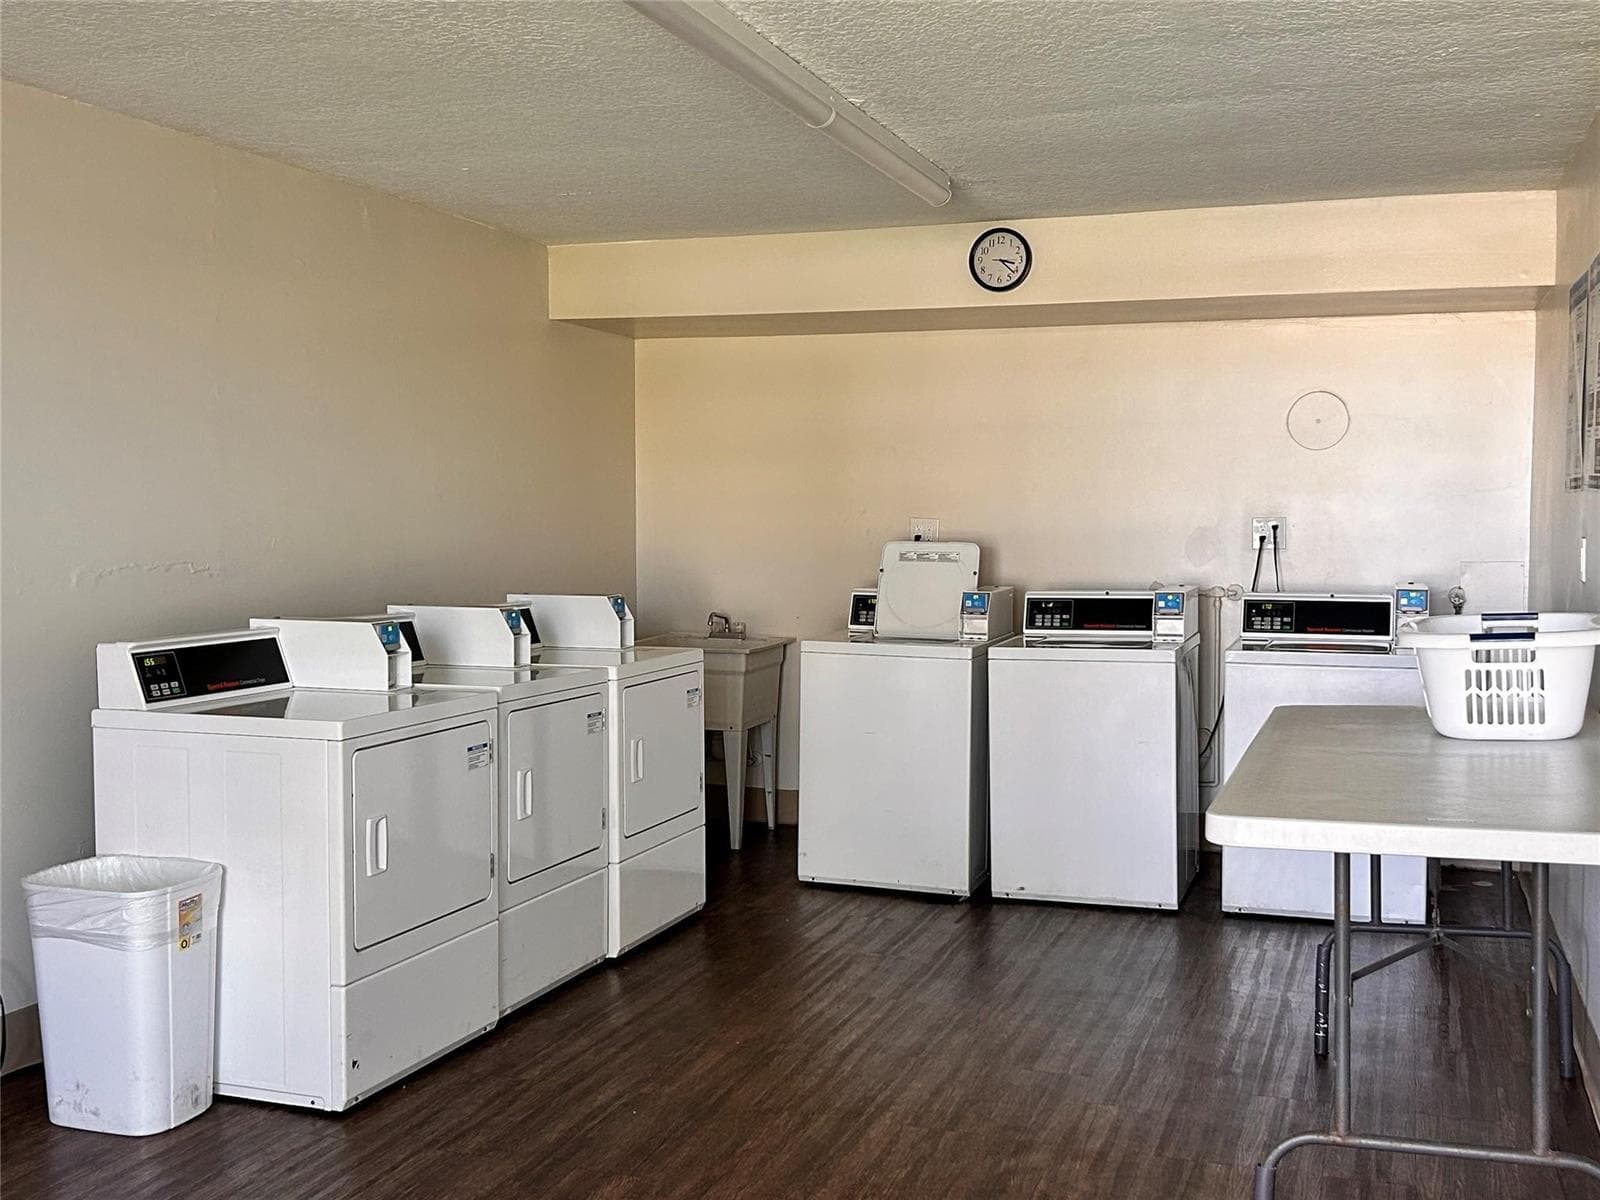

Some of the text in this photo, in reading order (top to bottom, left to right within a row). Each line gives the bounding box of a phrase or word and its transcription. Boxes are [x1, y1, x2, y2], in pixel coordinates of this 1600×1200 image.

[989, 239, 995, 247] 11
[997, 236, 1005, 244] 12
[980, 247, 989, 255] 10
[1015, 246, 1021, 254] 2
[1018, 255, 1023, 264] 3
[980, 266, 986, 274] 8
[988, 273, 992, 281] 7
[1006, 273, 1012, 282] 5
